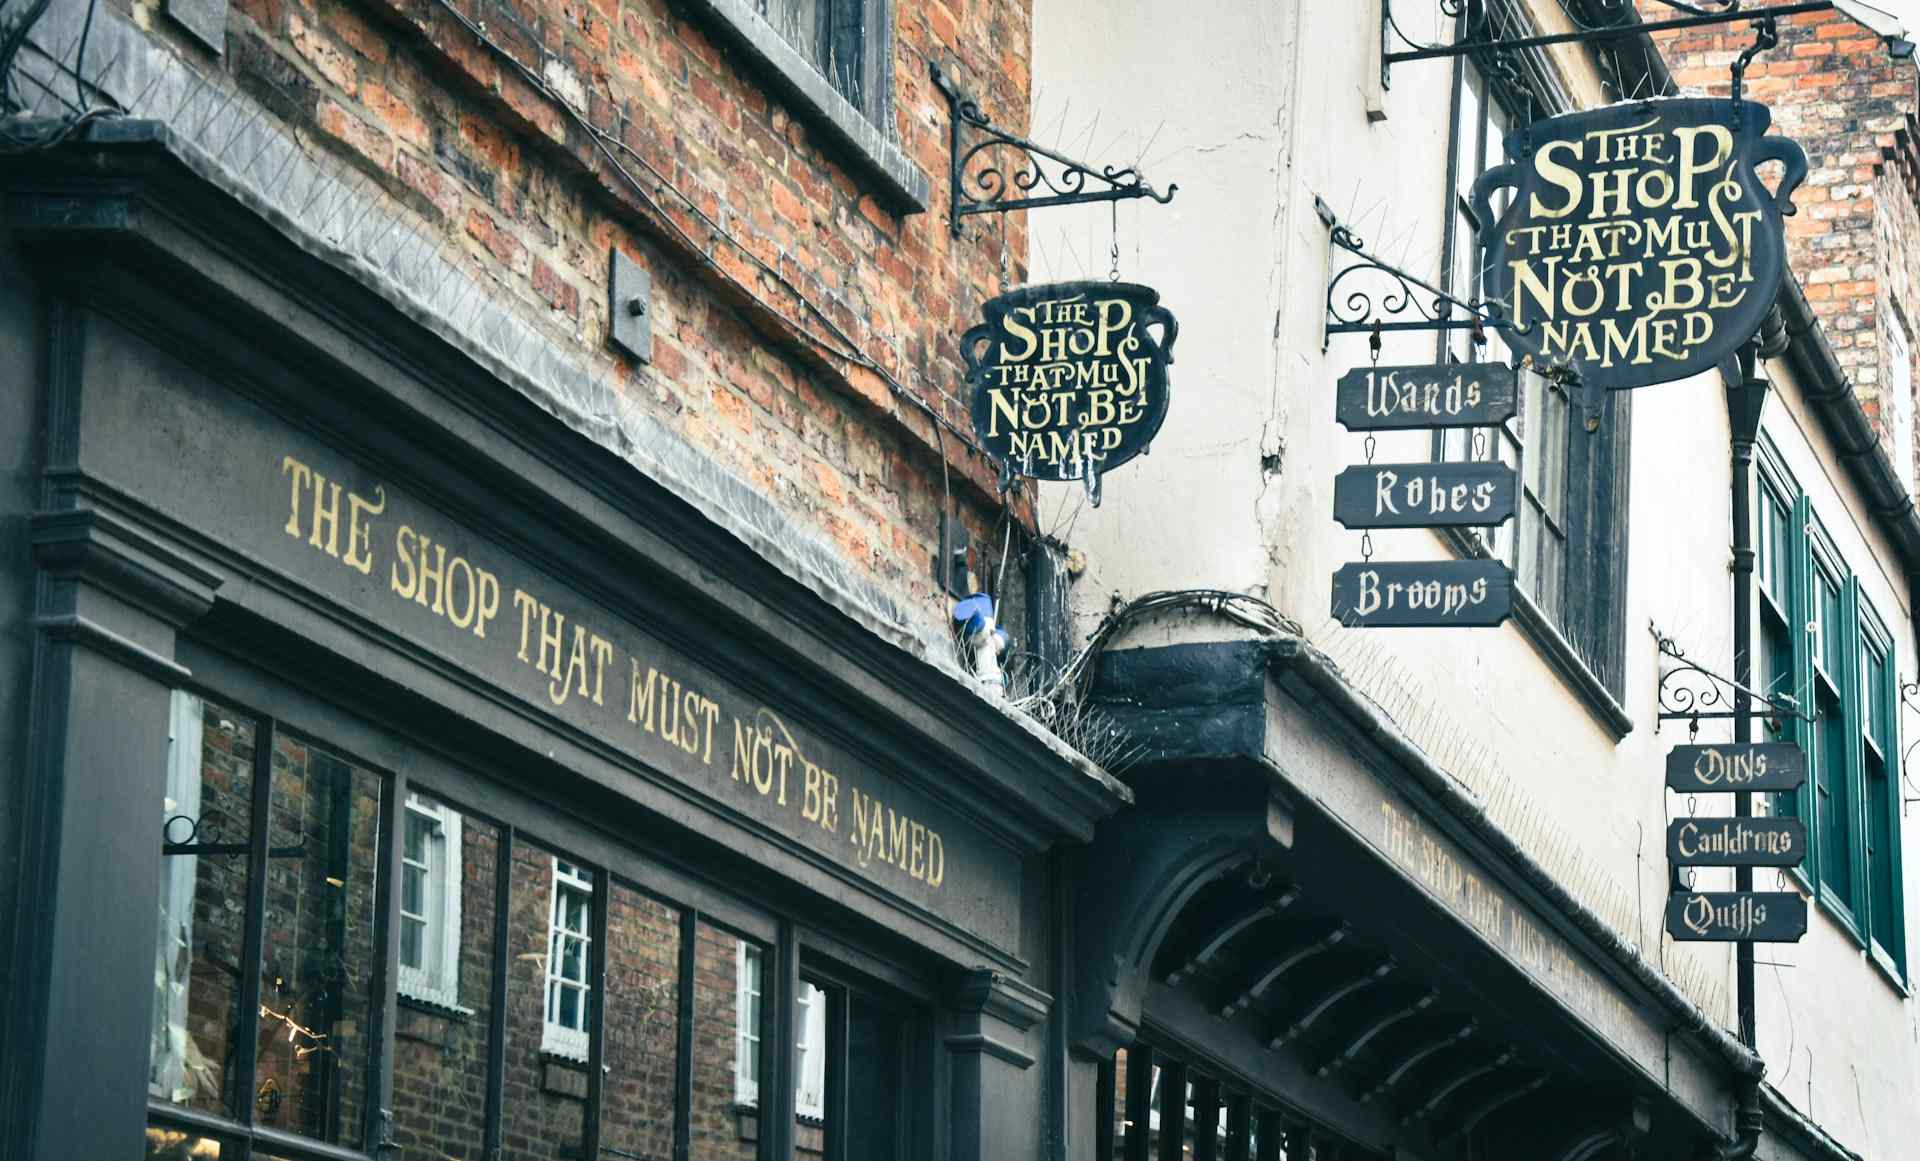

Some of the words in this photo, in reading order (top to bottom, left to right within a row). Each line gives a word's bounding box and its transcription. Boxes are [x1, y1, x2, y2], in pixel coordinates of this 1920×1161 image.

[1585, 116, 1674, 164] THE
[1530, 124, 1734, 219] SHOP
[1505, 220, 1642, 263] THAT
[1036, 293, 1095, 327] THE
[1507, 255, 1644, 331] NOT
[1646, 257, 1746, 322] BE
[1000, 299, 1132, 364] SHOP
[1539, 311, 1714, 368] NAMED
[985, 362, 1076, 391] THAT
[1365, 370, 1481, 418] Wands
[987, 387, 1076, 438] NOT
[1079, 389, 1143, 430] BE
[1008, 427, 1123, 465] NAMED
[1375, 470, 1497, 517] Robes
[1353, 569, 1489, 617] Brooms
[282, 456, 386, 575] THE
[391, 525, 500, 639] SHOP
[513, 588, 613, 706] THAT
[627, 657, 719, 765] MUST
[730, 707, 800, 806] NOT
[802, 760, 840, 833] BE
[850, 786, 945, 889] NAMED
[1694, 748, 1769, 785] Owls
[1677, 822, 1793, 858] Cauldrons
[1683, 894, 1768, 938] Quills
